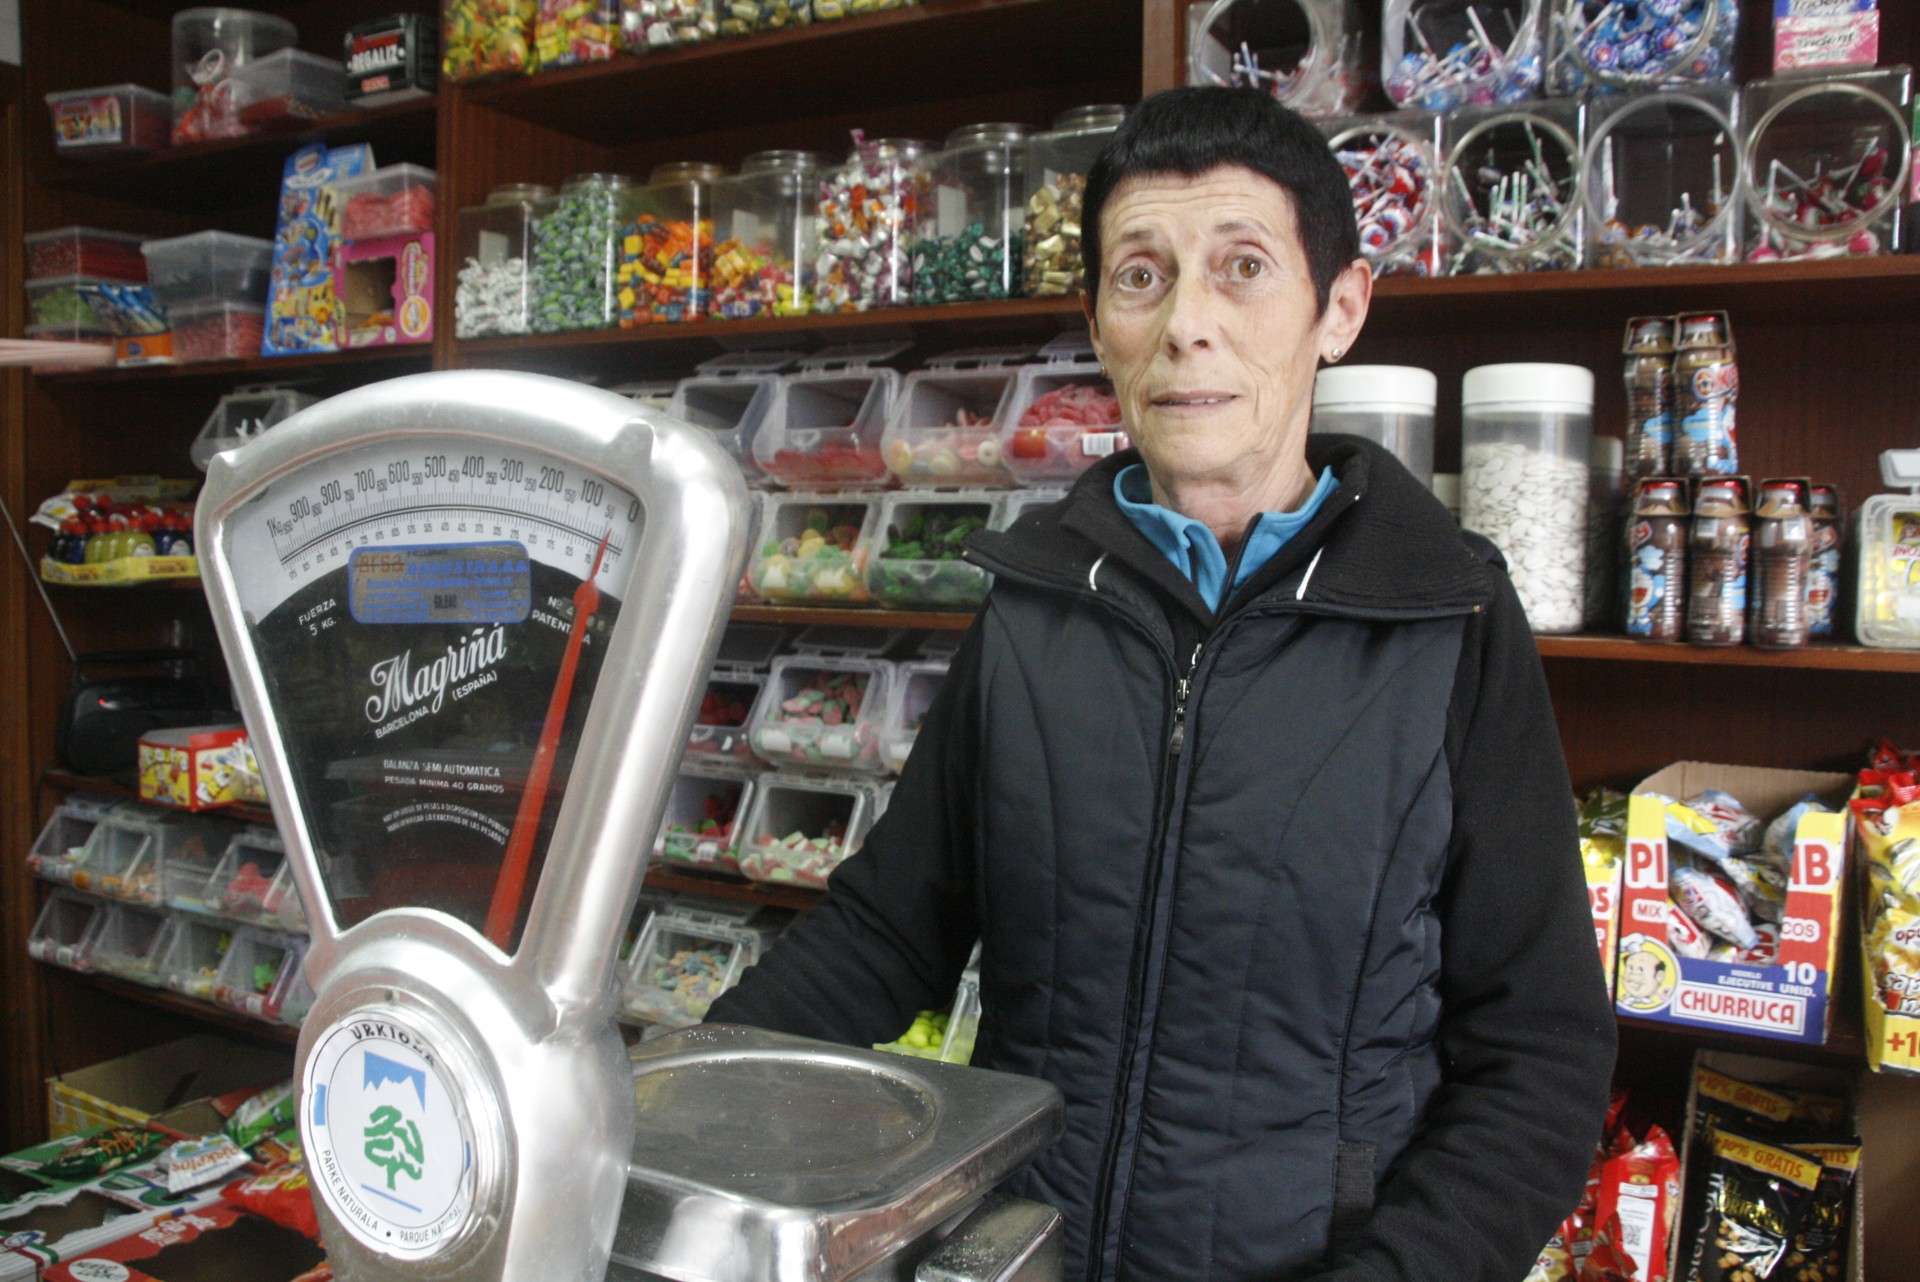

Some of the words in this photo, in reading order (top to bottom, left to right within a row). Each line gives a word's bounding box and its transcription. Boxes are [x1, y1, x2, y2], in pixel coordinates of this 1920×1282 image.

[352, 43, 398, 74] REGALIZ
[290, 496, 311, 522] 900
[354, 468, 376, 493] 700
[388, 460, 410, 484] 600
[424, 455, 446, 478] 500
[448, 469, 460, 483] 450
[461, 456, 484, 478] 400
[485, 471, 497, 485] 350
[500, 458, 524, 483] 300
[524, 478, 537, 492] 250
[538, 466, 565, 493] 200
[564, 488, 576, 504] 150
[580, 478, 604, 507] 100
[604, 504, 616, 519] 50
[627, 500, 640, 523] 0
[298, 598, 337, 626] FUERZA
[309, 624, 318, 637] 5
[321, 616, 337, 630] KG.
[531, 608, 592, 645] PATENTA
[365, 622, 507, 723] Magriñá
[375, 704, 430, 739] BARCELONA
[451, 669, 498, 701] (ESPAÑA)
[383, 759, 420, 771] BALANZA
[443, 763, 501, 777] AUTOMATICA
[384, 775, 417, 785] PESADA
[418, 778, 449, 789] MINIMA
[451, 781, 464, 790] 40
[466, 782, 505, 794] GRAMOS
[423, 802, 440, 811] PESAS
[445, 803, 479, 818] DISPOSICION
[469, 820, 481, 831] LAS
[1636, 904, 1662, 918] MIX
[1718, 975, 1774, 992] EJECUTIVE
[1783, 960, 1817, 985] 10
[1779, 983, 1817, 999] UNID.
[1680, 989, 1796, 1026] CHURRUCA
[1886, 1030, 1920, 1059] +1
[1714, 1137, 1749, 1158] +10%
[1753, 1149, 1805, 1179] GRATIS
[322, 1149, 341, 1187] PARKE
[337, 1184, 379, 1231] NATURALA
[400, 1229, 430, 1243] PARQUE
